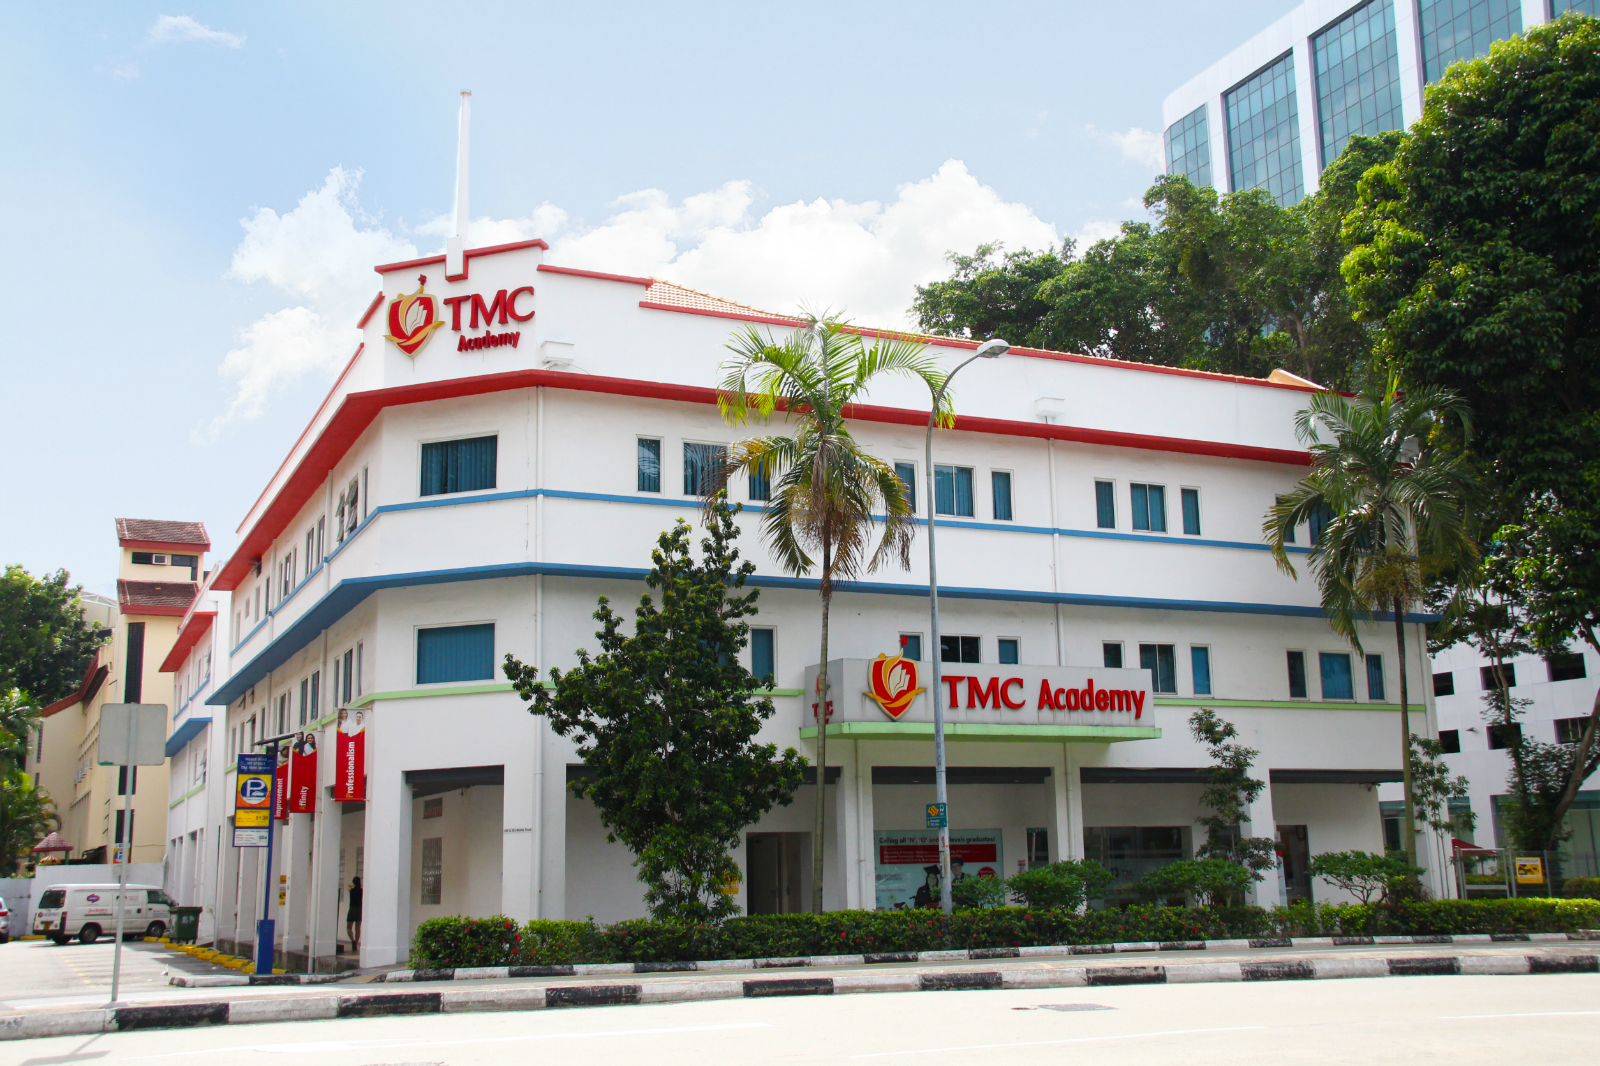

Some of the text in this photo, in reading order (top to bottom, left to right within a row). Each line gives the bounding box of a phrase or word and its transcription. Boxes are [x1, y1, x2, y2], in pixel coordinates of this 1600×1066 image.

[443, 286, 536, 331] TMC
[457, 330, 520, 352] Academy
[811, 700, 834, 718] TC
[941, 675, 1146, 720] TMC Academy
[345, 741, 356, 798] Professionalism
[298, 786, 309, 811] Affinity
[879, 836, 899, 845] Calling
[966, 836, 995, 844] graduates!
